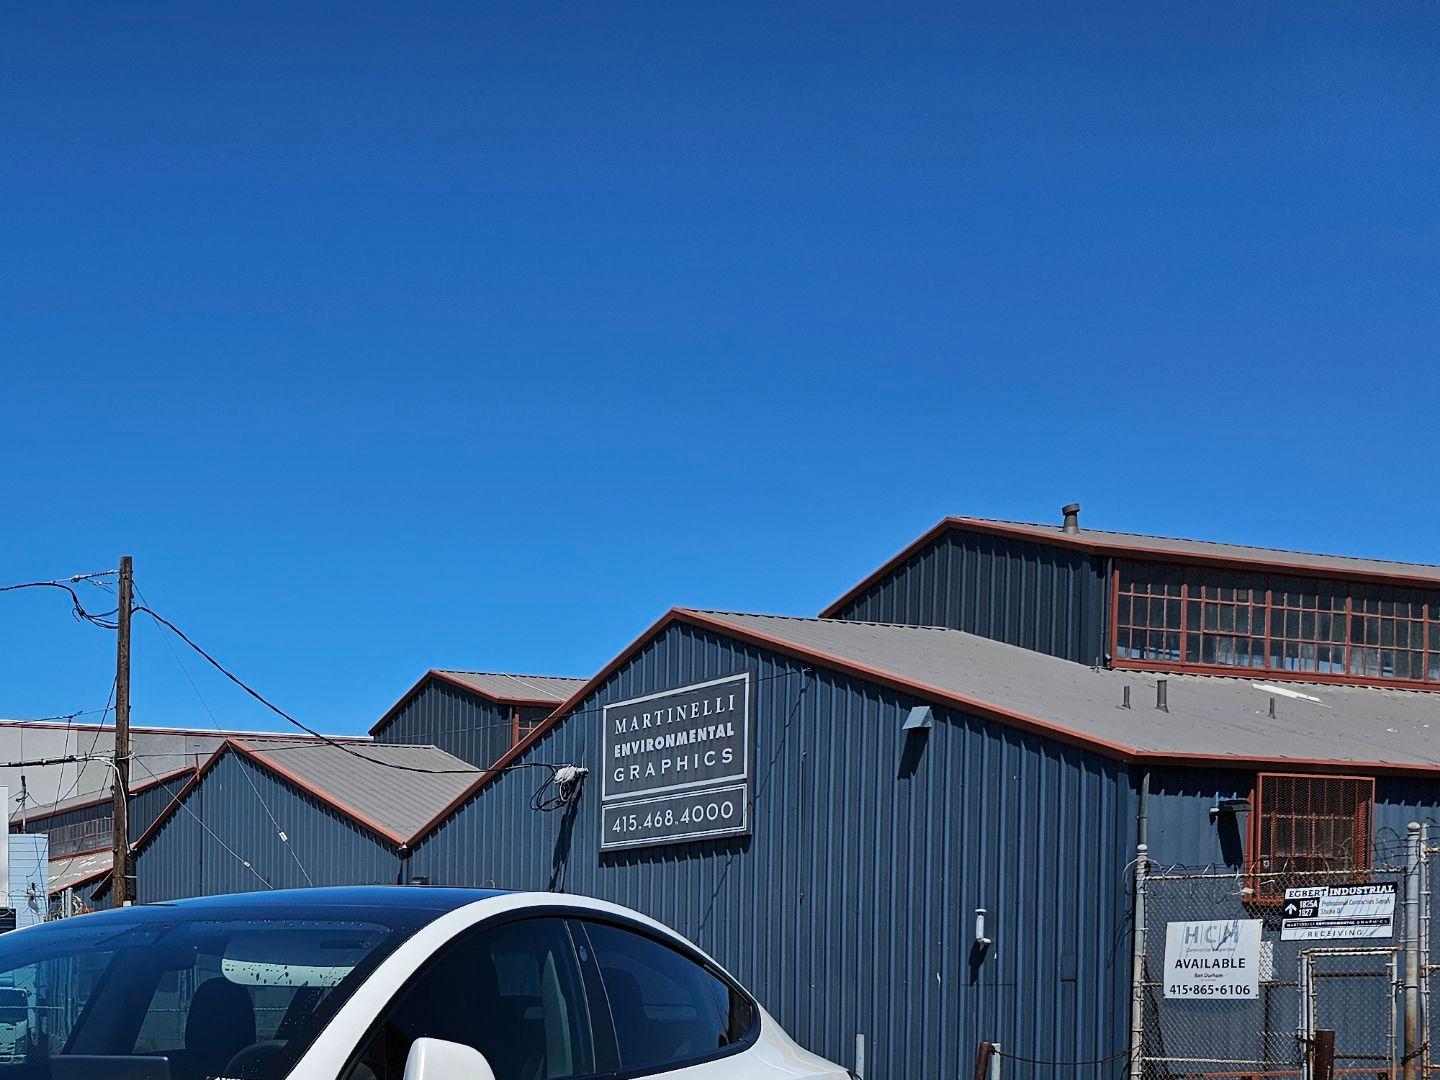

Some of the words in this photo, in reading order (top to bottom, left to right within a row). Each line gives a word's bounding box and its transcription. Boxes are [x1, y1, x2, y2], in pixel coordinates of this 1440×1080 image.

[614, 694, 735, 735] MARTINELLI
[614, 722, 735, 758] ENVIRONMENTAL
[613, 747, 733, 782] GRAPHICS
[612, 801, 733, 833] 415.468.4000
[1288, 887, 1328, 898] EGBERT
[1329, 884, 1395, 897] INDUSTRIAL
[1307, 929, 1363, 938] RECEIVING
[1174, 957, 1246, 969] AVAILABLE
